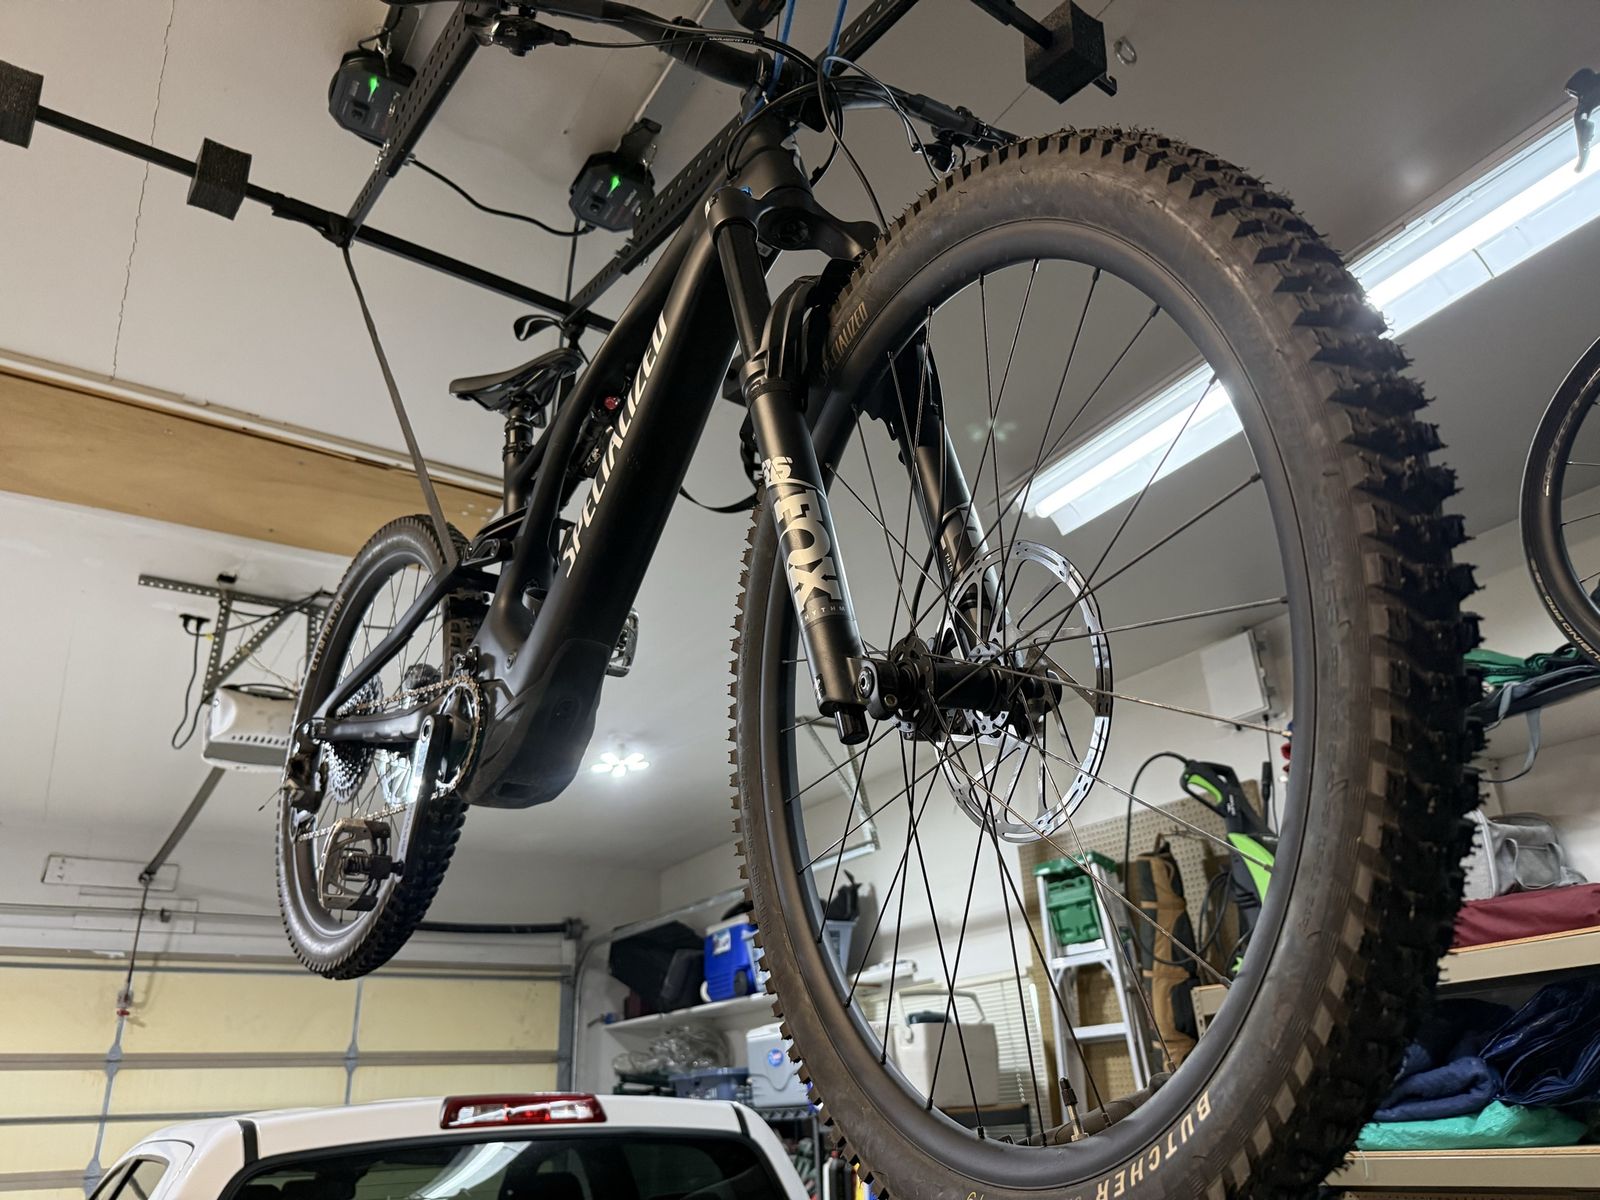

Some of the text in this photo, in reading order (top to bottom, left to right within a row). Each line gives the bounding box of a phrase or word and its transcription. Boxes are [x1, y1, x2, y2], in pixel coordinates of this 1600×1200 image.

[562, 310, 669, 578] SPECIALIZED
[773, 489, 842, 614] FOX
[804, 605, 847, 621] HYTHM
[1562, 622, 1600, 662] UBINO
[1096, 1090, 1212, 1200] BUTCHER
